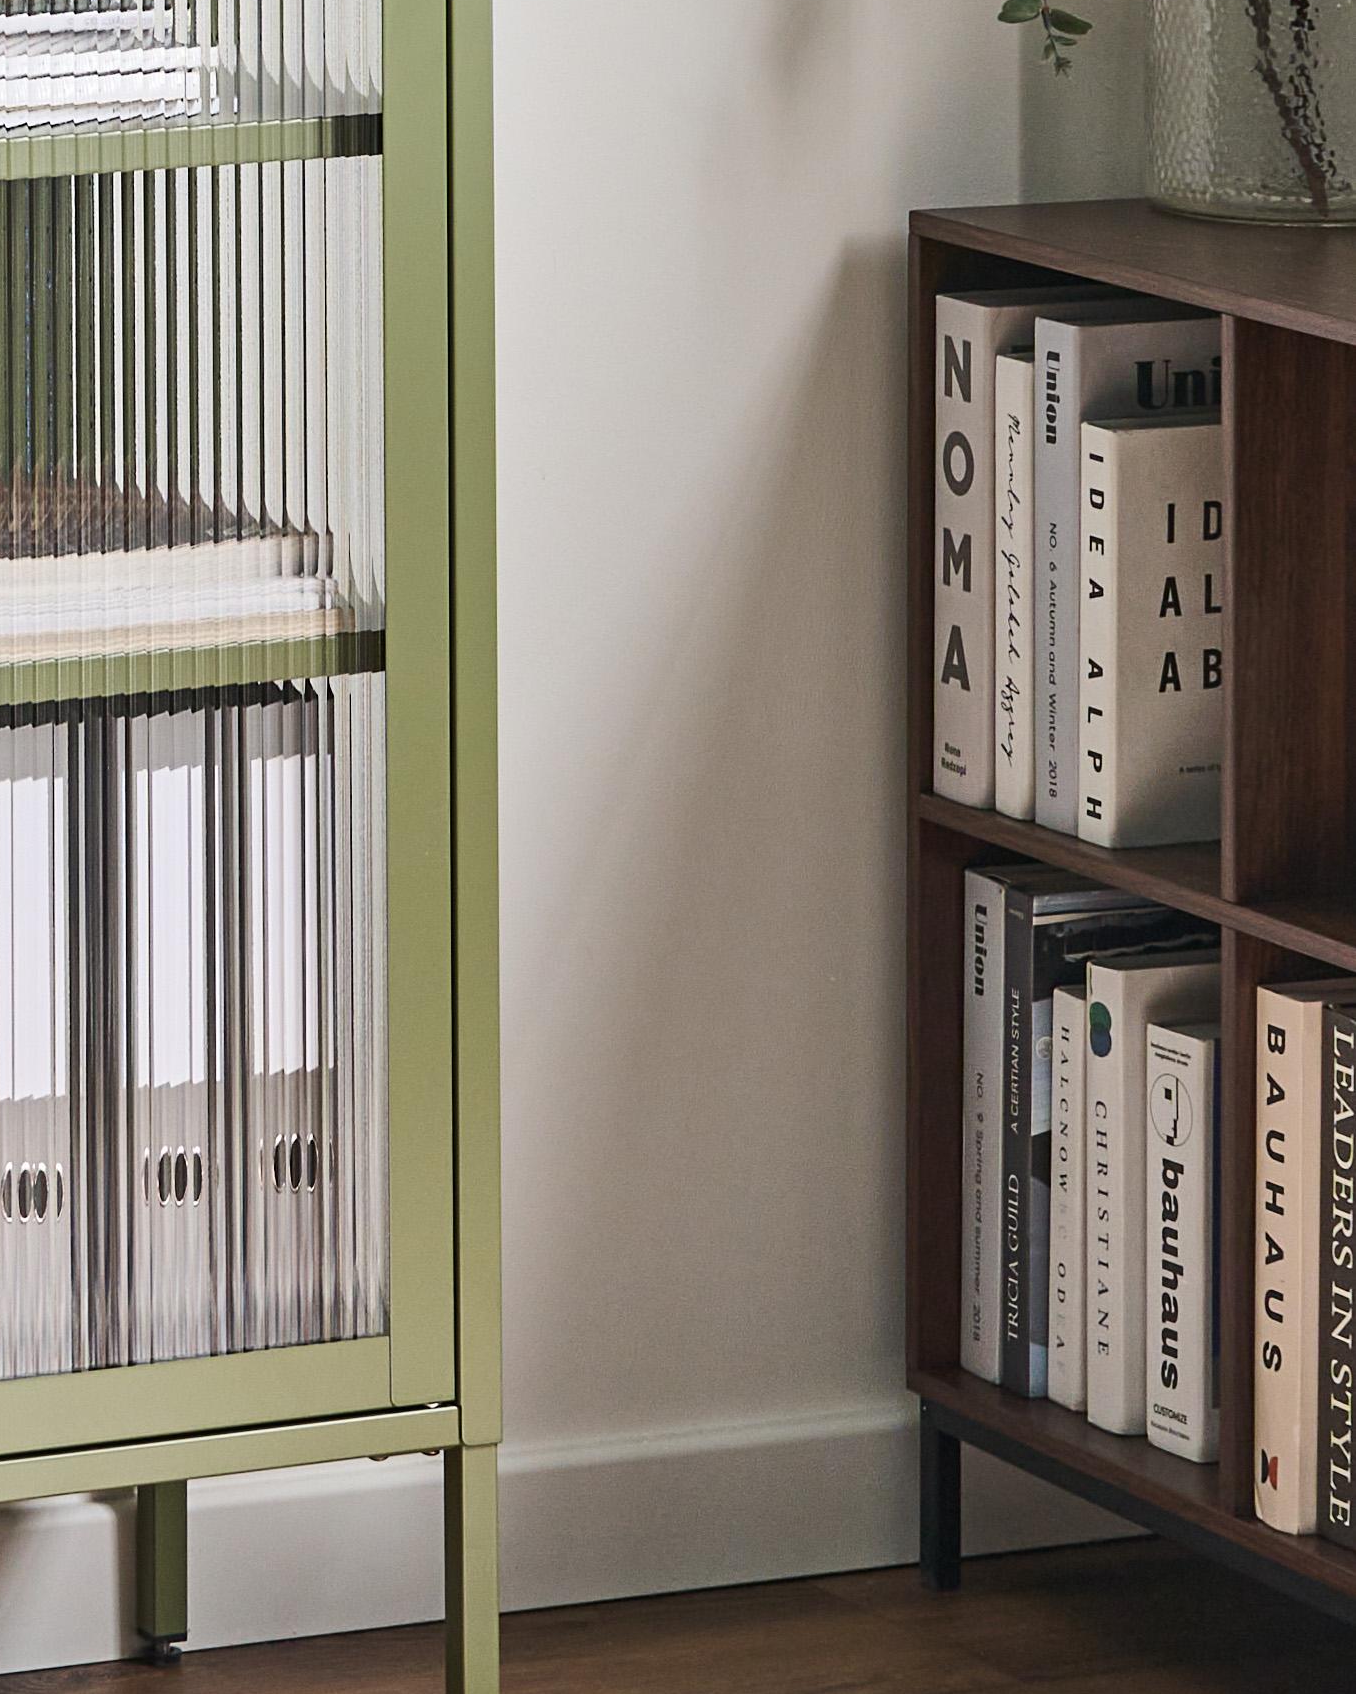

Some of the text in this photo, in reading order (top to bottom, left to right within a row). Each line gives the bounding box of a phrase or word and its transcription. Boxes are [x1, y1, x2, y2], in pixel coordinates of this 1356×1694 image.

[1046, 351, 1061, 444] Union
[941, 335, 975, 692] NOMA
[1049, 562, 1058, 572] 6
[1049, 580, 1058, 647] Autumn
[1087, 453, 1105, 819] IDEA ALPH
[1049, 652, 1058, 685] and
[1048, 694, 1057, 751] Winter
[1048, 760, 1058, 798] 2018
[975, 904, 988, 996] Union
[1010, 988, 1020, 1134] A CERTIAN STYLE
[975, 1130, 985, 1186] Spring
[1263, 1024, 1286, 1372] BAUHAUS
[975, 1189, 984, 1223] and
[1095, 1100, 1111, 1356] CHRISTIANE
[1008, 1174, 1019, 1339] TRICIA GUILD
[1161, 1158, 1185, 1390] bauhaus
[1329, 1025, 1355, 1526] LEADERS IN STYLE
[972, 1304, 982, 1342] 2018
